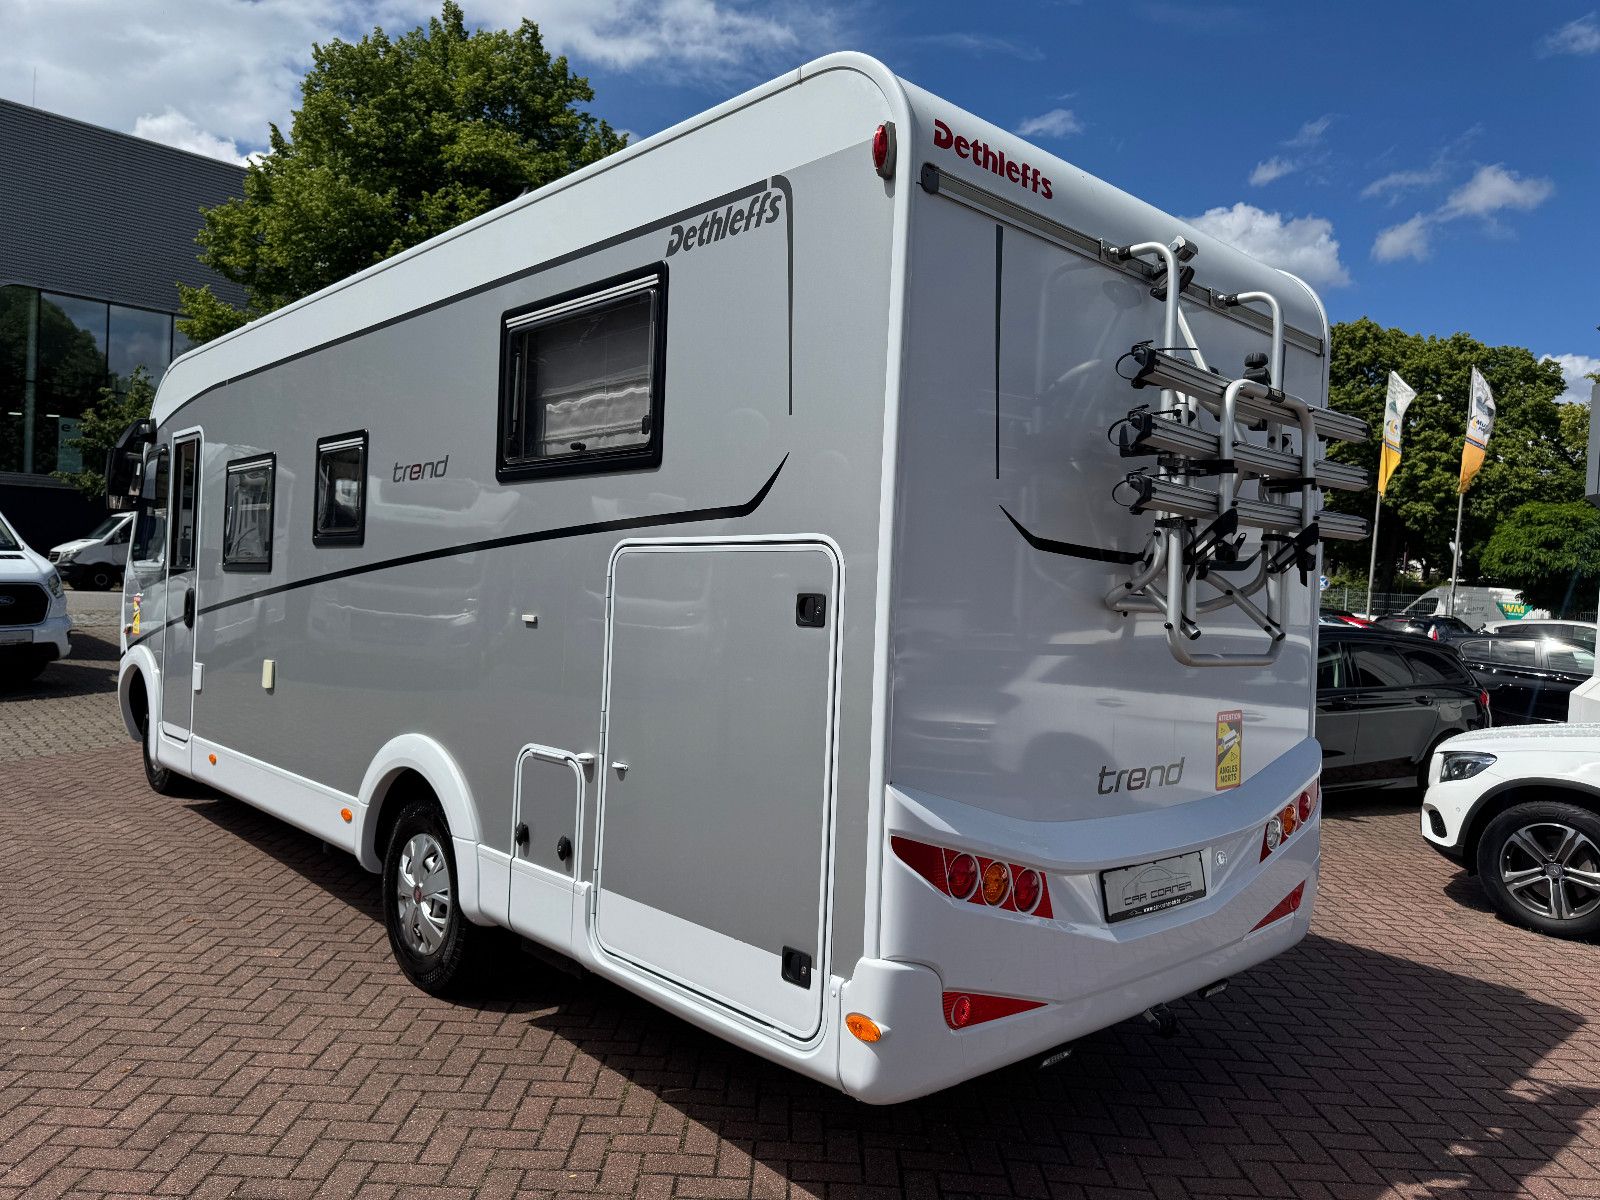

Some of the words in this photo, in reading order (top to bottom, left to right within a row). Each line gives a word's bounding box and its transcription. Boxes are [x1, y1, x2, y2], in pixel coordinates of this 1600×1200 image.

[934, 118, 1053, 200] Dethleffs
[666, 191, 782, 257] Dethleffs
[393, 454, 449, 482] trend
[1503, 603, 1525, 614] WM
[1218, 713, 1241, 721] ATTENTION
[1097, 756, 1185, 795] trend
[1219, 764, 1238, 775] ANGLES
[1220, 774, 1237, 783] MORTS
[1124, 893, 1148, 906] CAR
[1150, 880, 1192, 899] CORNER
